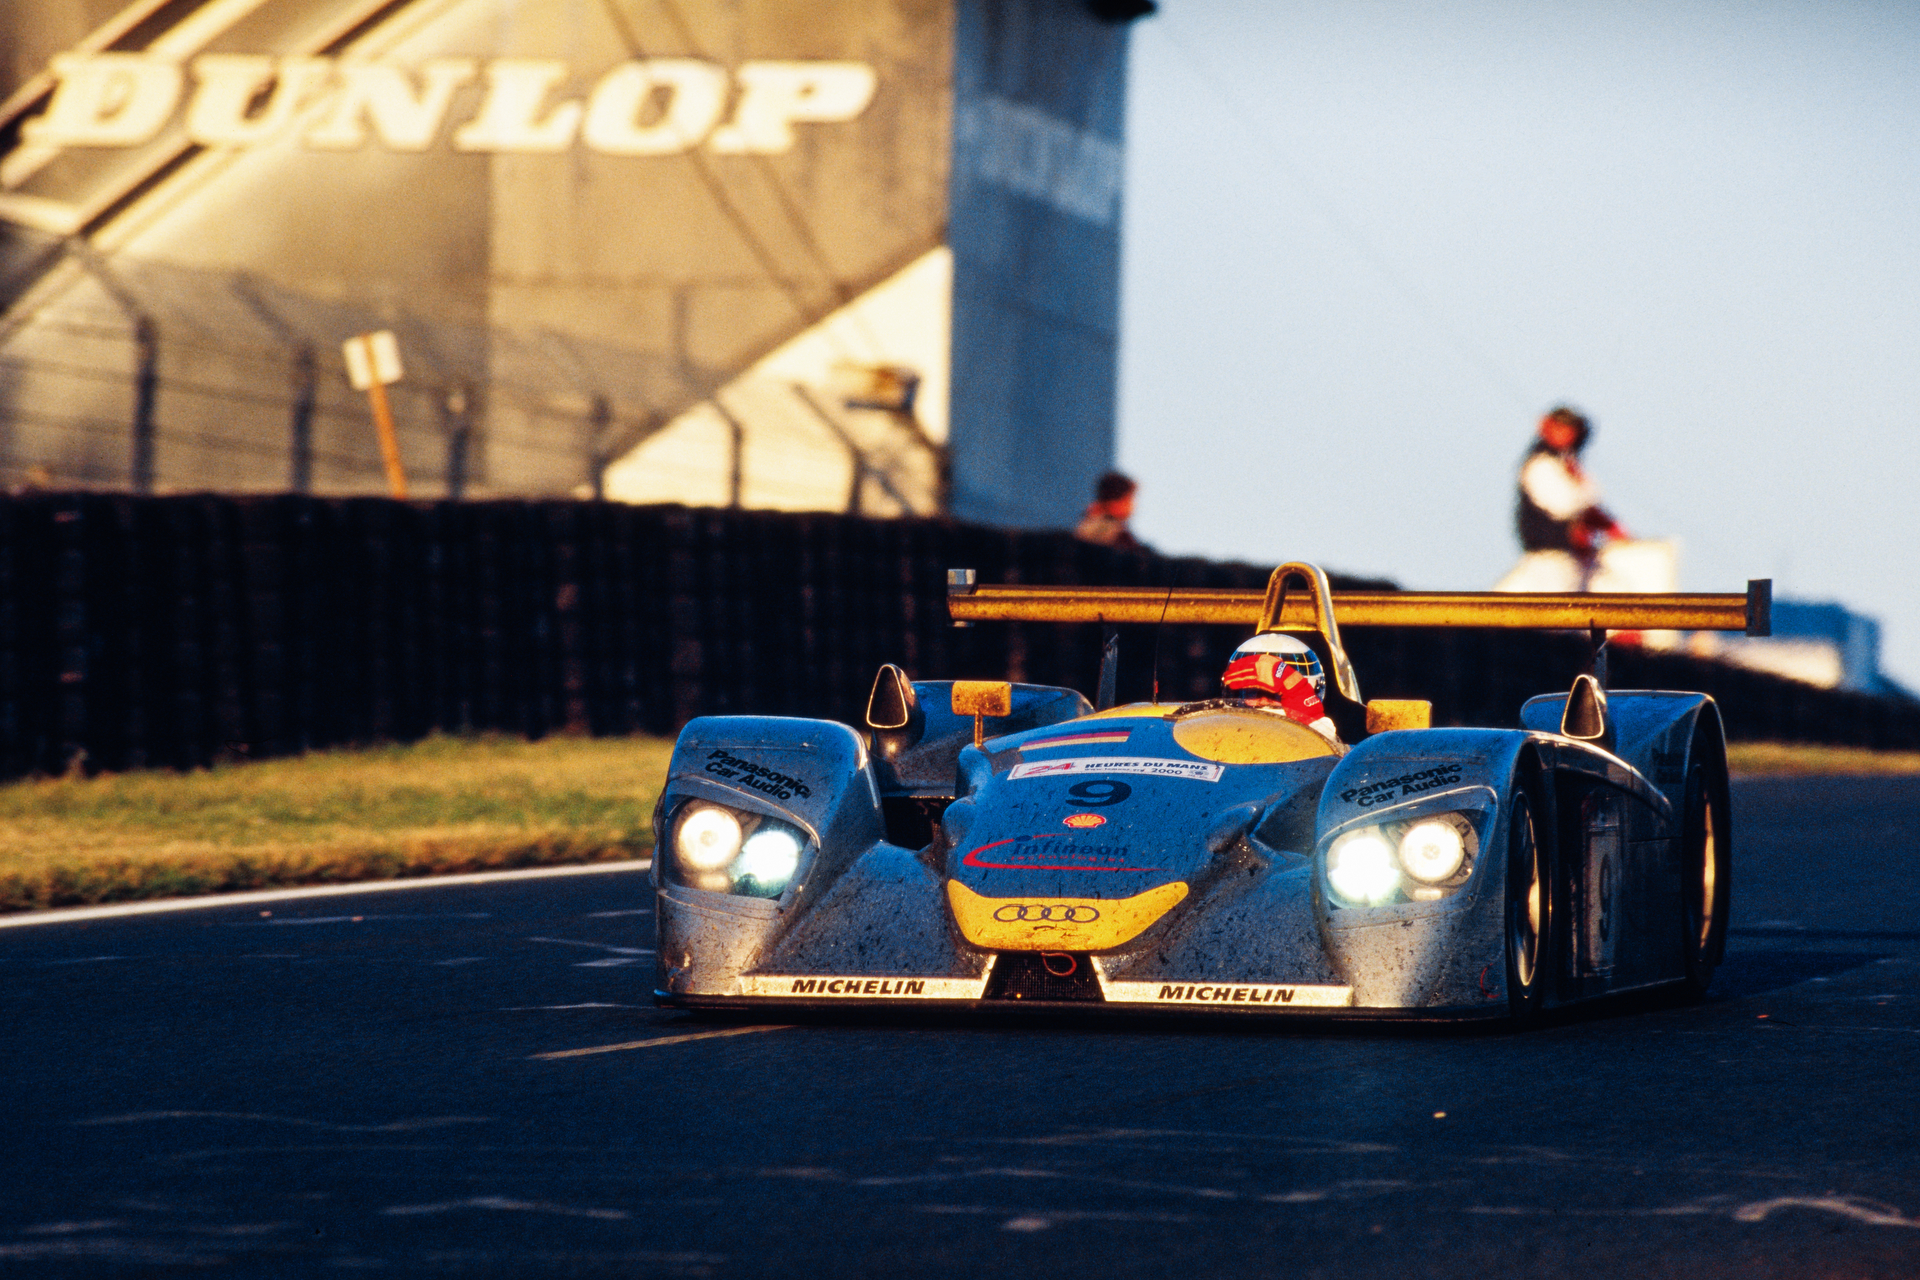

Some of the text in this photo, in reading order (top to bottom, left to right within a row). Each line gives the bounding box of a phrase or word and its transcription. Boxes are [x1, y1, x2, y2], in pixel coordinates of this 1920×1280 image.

[20, 52, 878, 154] DUNLOP
[707, 750, 812, 799] Panasonic
[1151, 768, 1183, 776] 2000
[1166, 763, 1209, 771] MANS
[705, 762, 791, 800] Car Audio
[1065, 780, 1132, 807] 9
[1340, 764, 1463, 804] Panasonic
[1357, 775, 1461, 807] Car Audio
[1013, 840, 1128, 856] Infineon
[791, 979, 925, 995] MICHELIN
[1158, 985, 1296, 1003] MICHELIN
